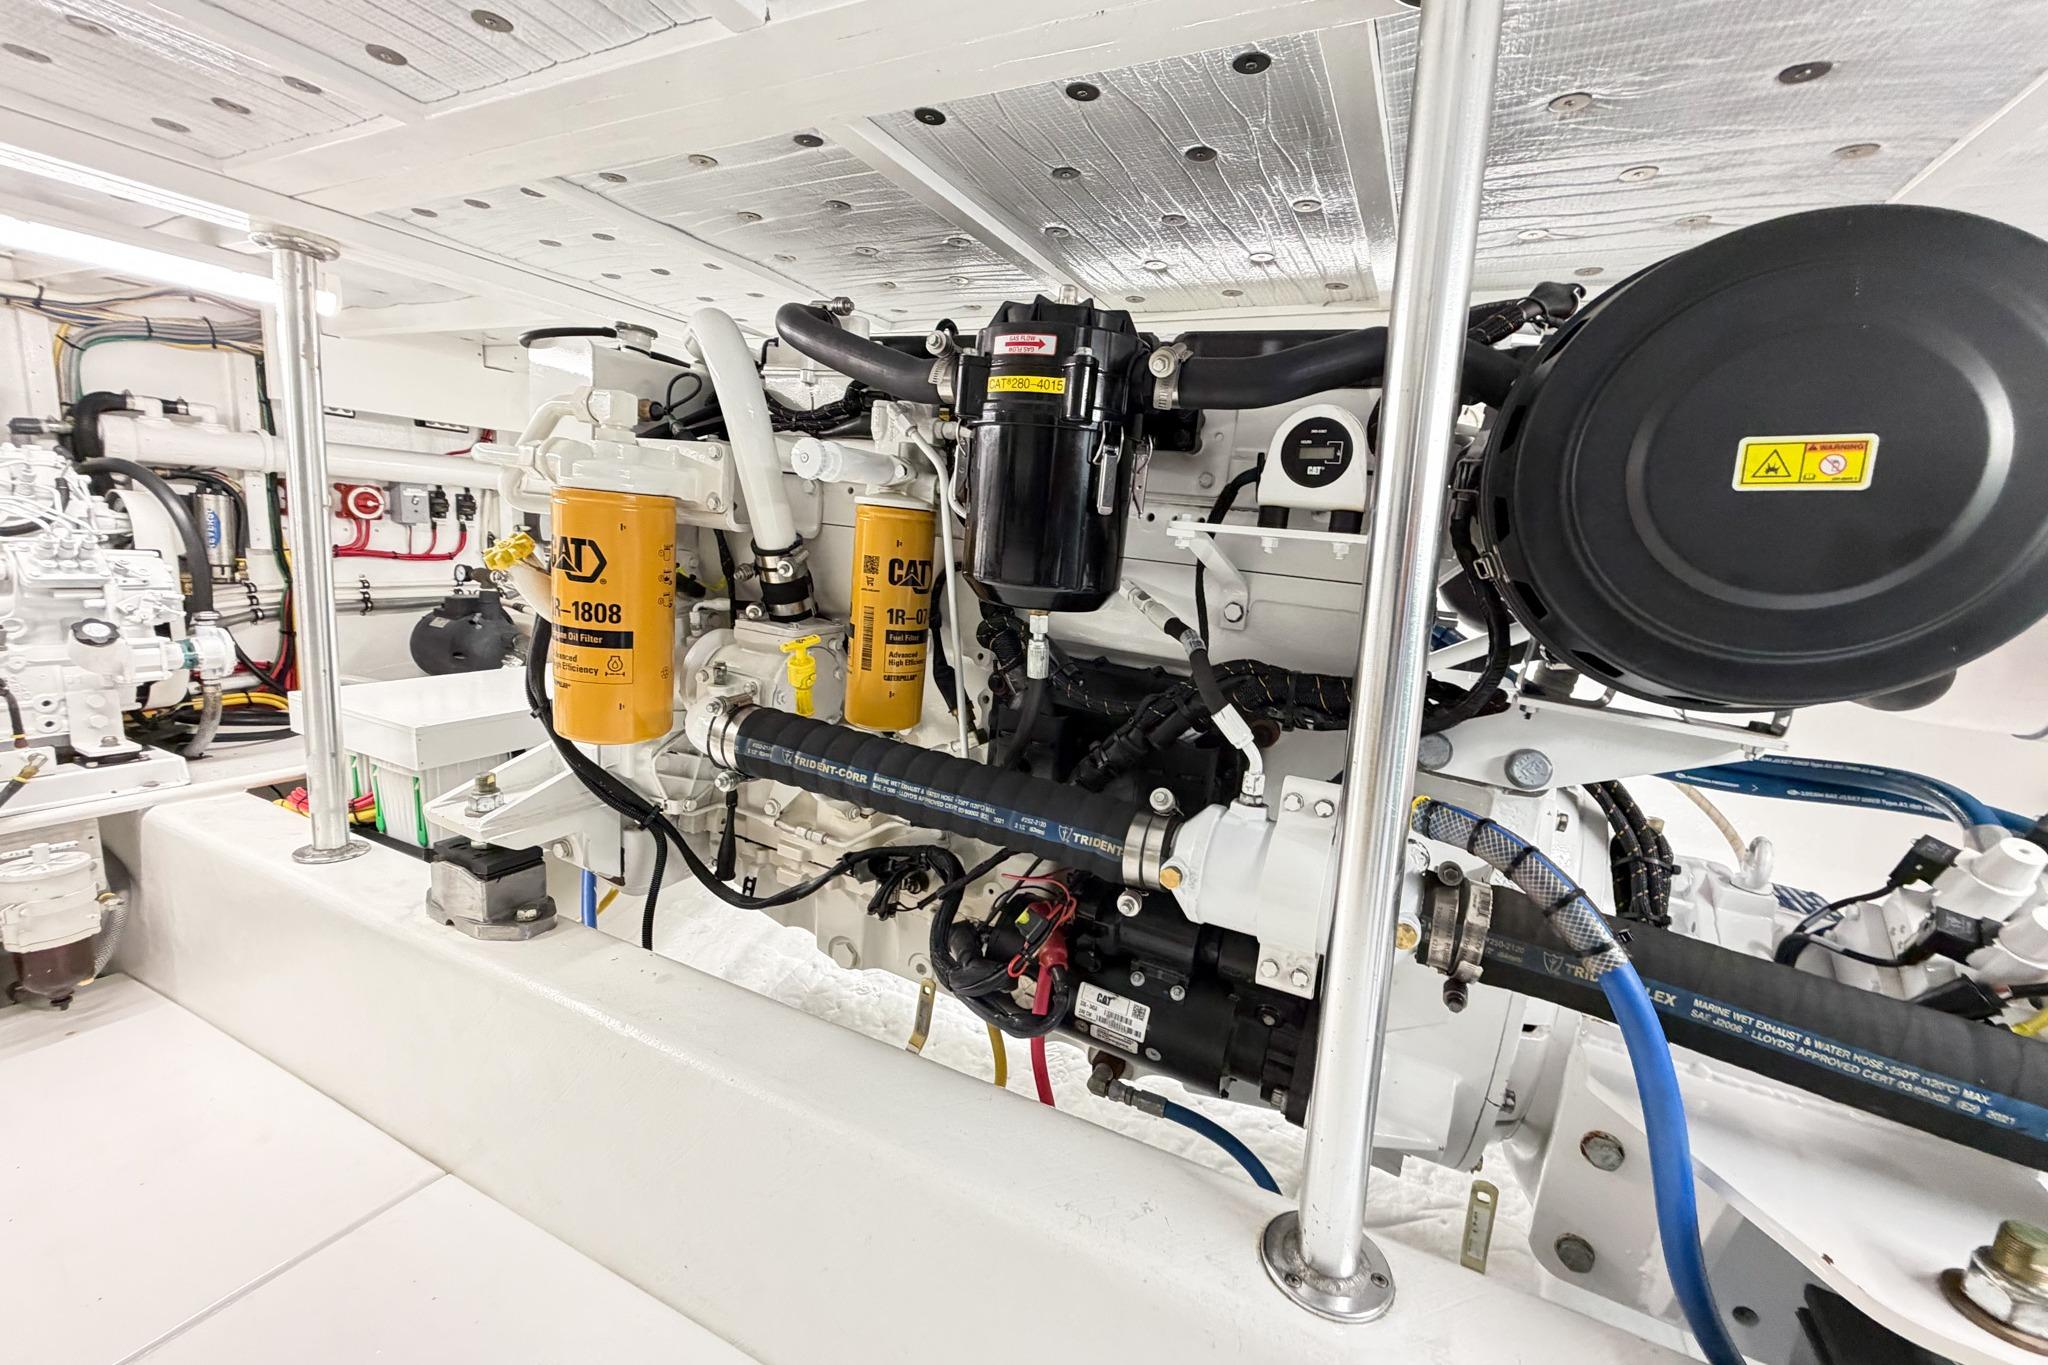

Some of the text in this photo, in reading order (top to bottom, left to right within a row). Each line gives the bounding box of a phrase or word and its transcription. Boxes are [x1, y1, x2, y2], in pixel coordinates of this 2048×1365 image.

[1820, 443, 1864, 451] WARNING
[888, 557, 933, 588] CAT
[568, 631, 579, 642] Oil
[580, 633, 603, 644] Filter
[888, 651, 918, 659] Advanced
[888, 659, 903, 668] High
[794, 755, 868, 784] TRIDENT-CORR
[1096, 992, 1112, 1007] CAT
[1693, 998, 1732, 1018] MARINE
[1732, 1010, 1755, 1026] WET
[1755, 1020, 1803, 1043] EXHAUST
[1803, 1036, 1812, 1046] &
[1813, 1039, 1851, 1060] WATER
[1690, 1008, 1712, 1023] SAE
[1751, 1030, 1796, 1052] LLOYD'S
[1795, 1046, 1861, 1074] APPROVED
[1861, 1068, 1897, 1086] CERT
